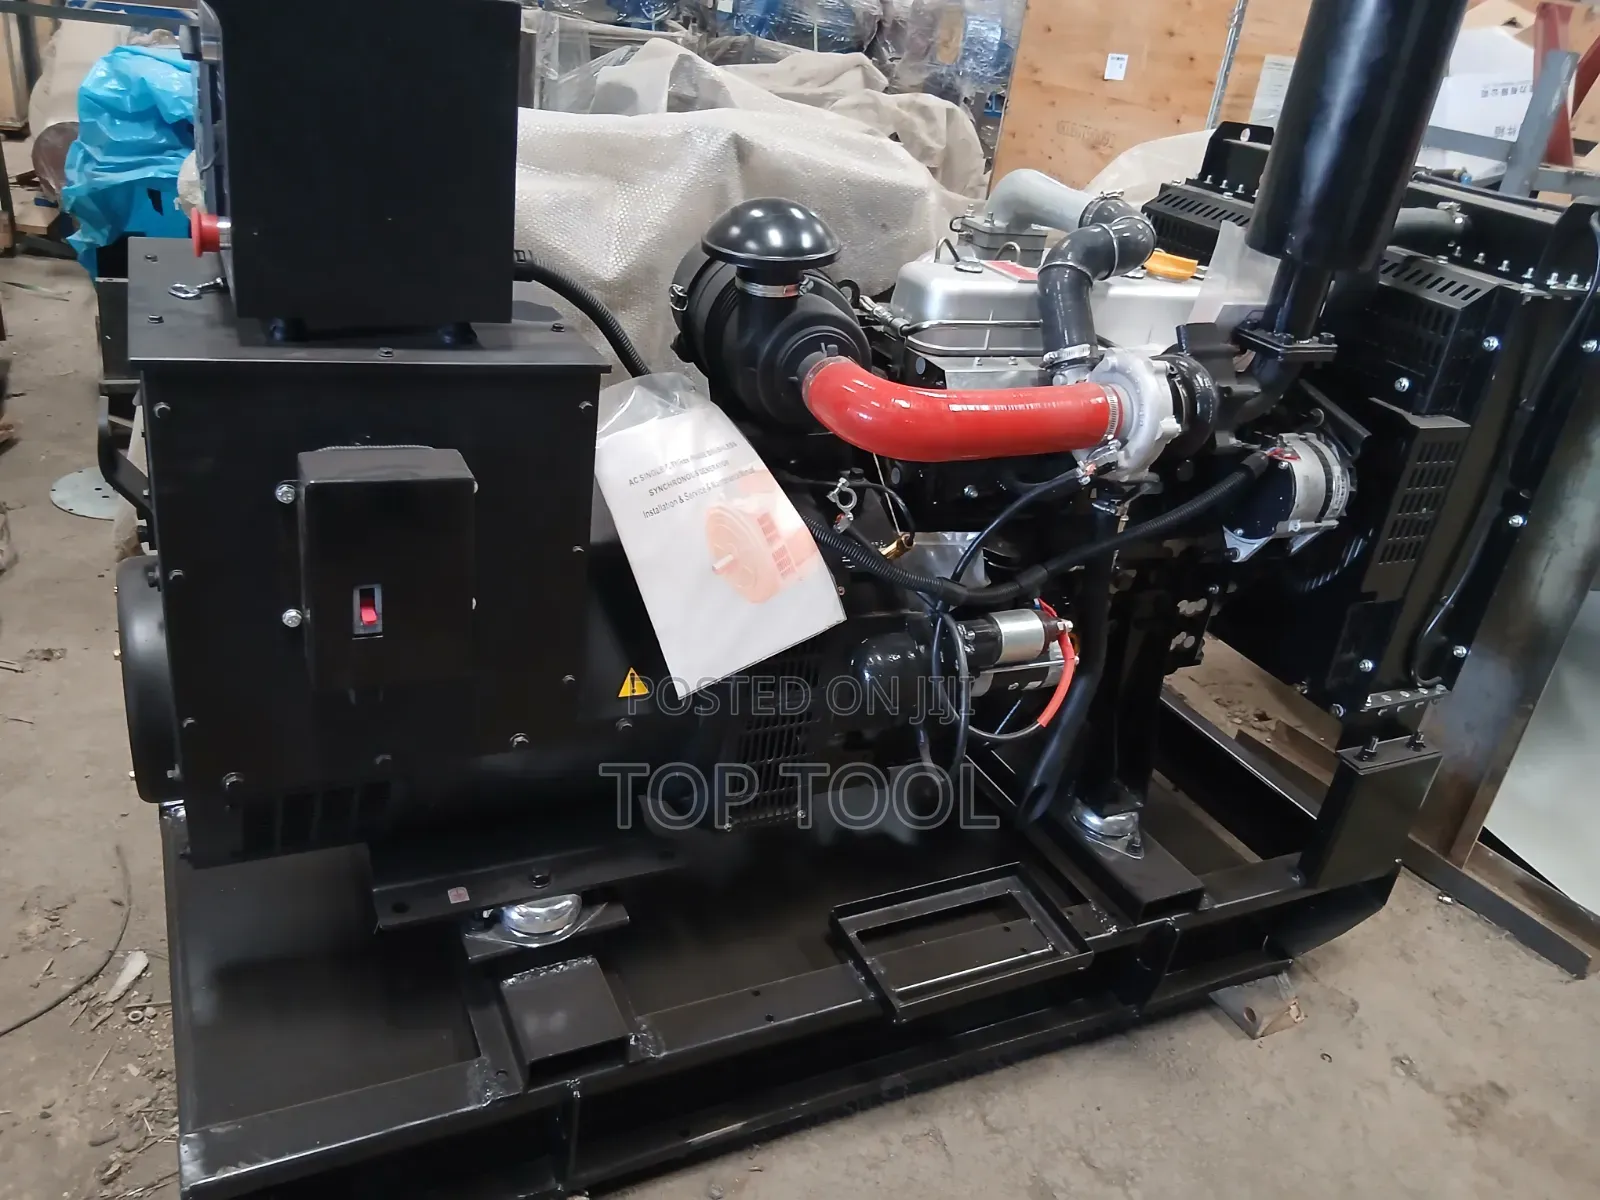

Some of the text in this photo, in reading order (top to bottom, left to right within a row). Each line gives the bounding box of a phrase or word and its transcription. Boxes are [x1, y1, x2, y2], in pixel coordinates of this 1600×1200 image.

[628, 478, 639, 486] AC
[640, 464, 667, 481] SINGLE
[648, 470, 700, 496] SYNCHRONOUS
[642, 497, 679, 519] Installation
[679, 494, 685, 504] &
[684, 486, 707, 501] Service
